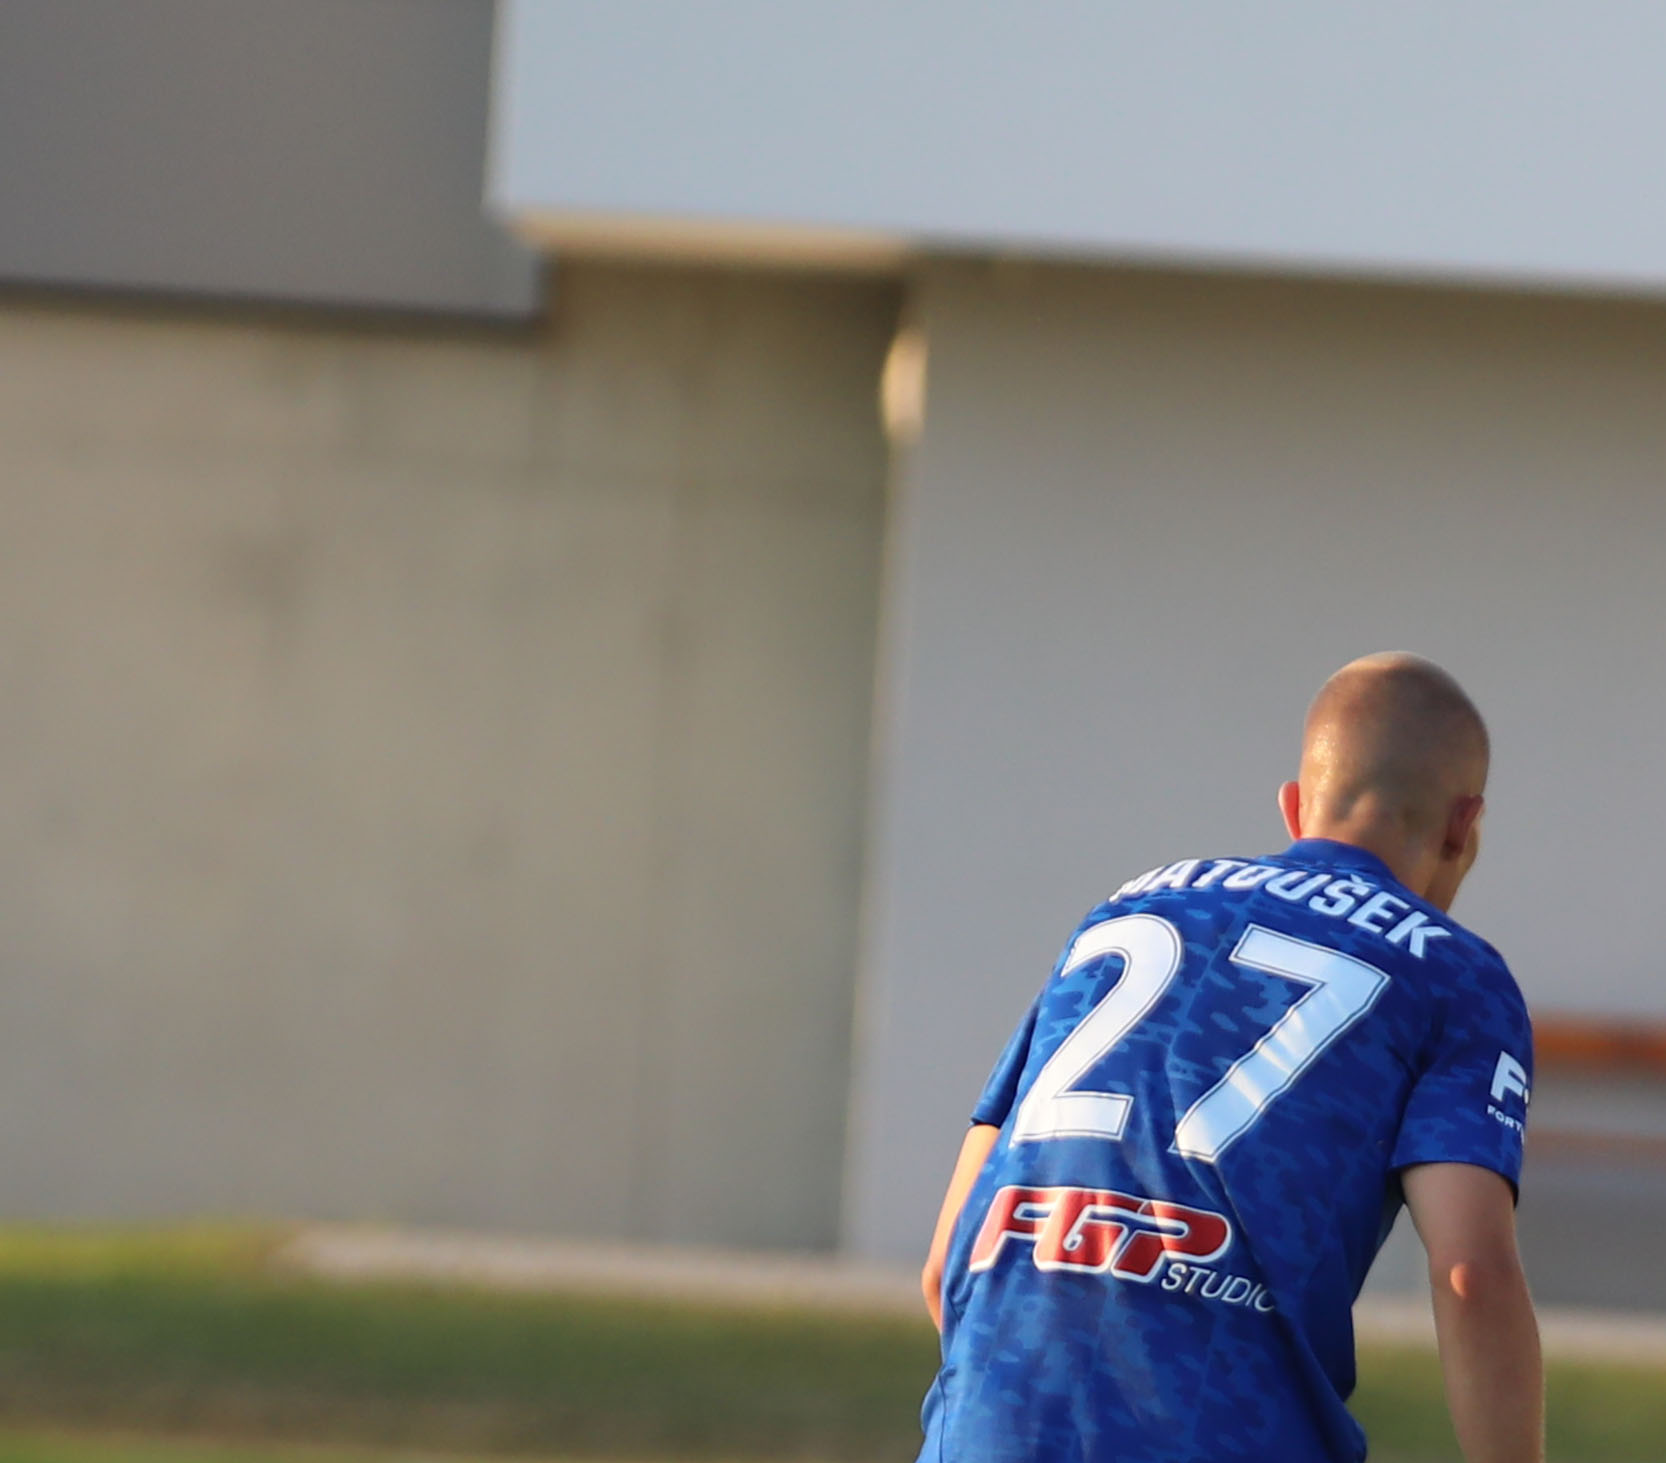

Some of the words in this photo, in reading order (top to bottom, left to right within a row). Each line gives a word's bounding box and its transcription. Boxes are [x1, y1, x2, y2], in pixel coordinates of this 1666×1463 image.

[1008, 912, 1392, 1165] 27
[1487, 1104, 1525, 1145] FORT
[968, 1185, 1232, 1284] FGP
